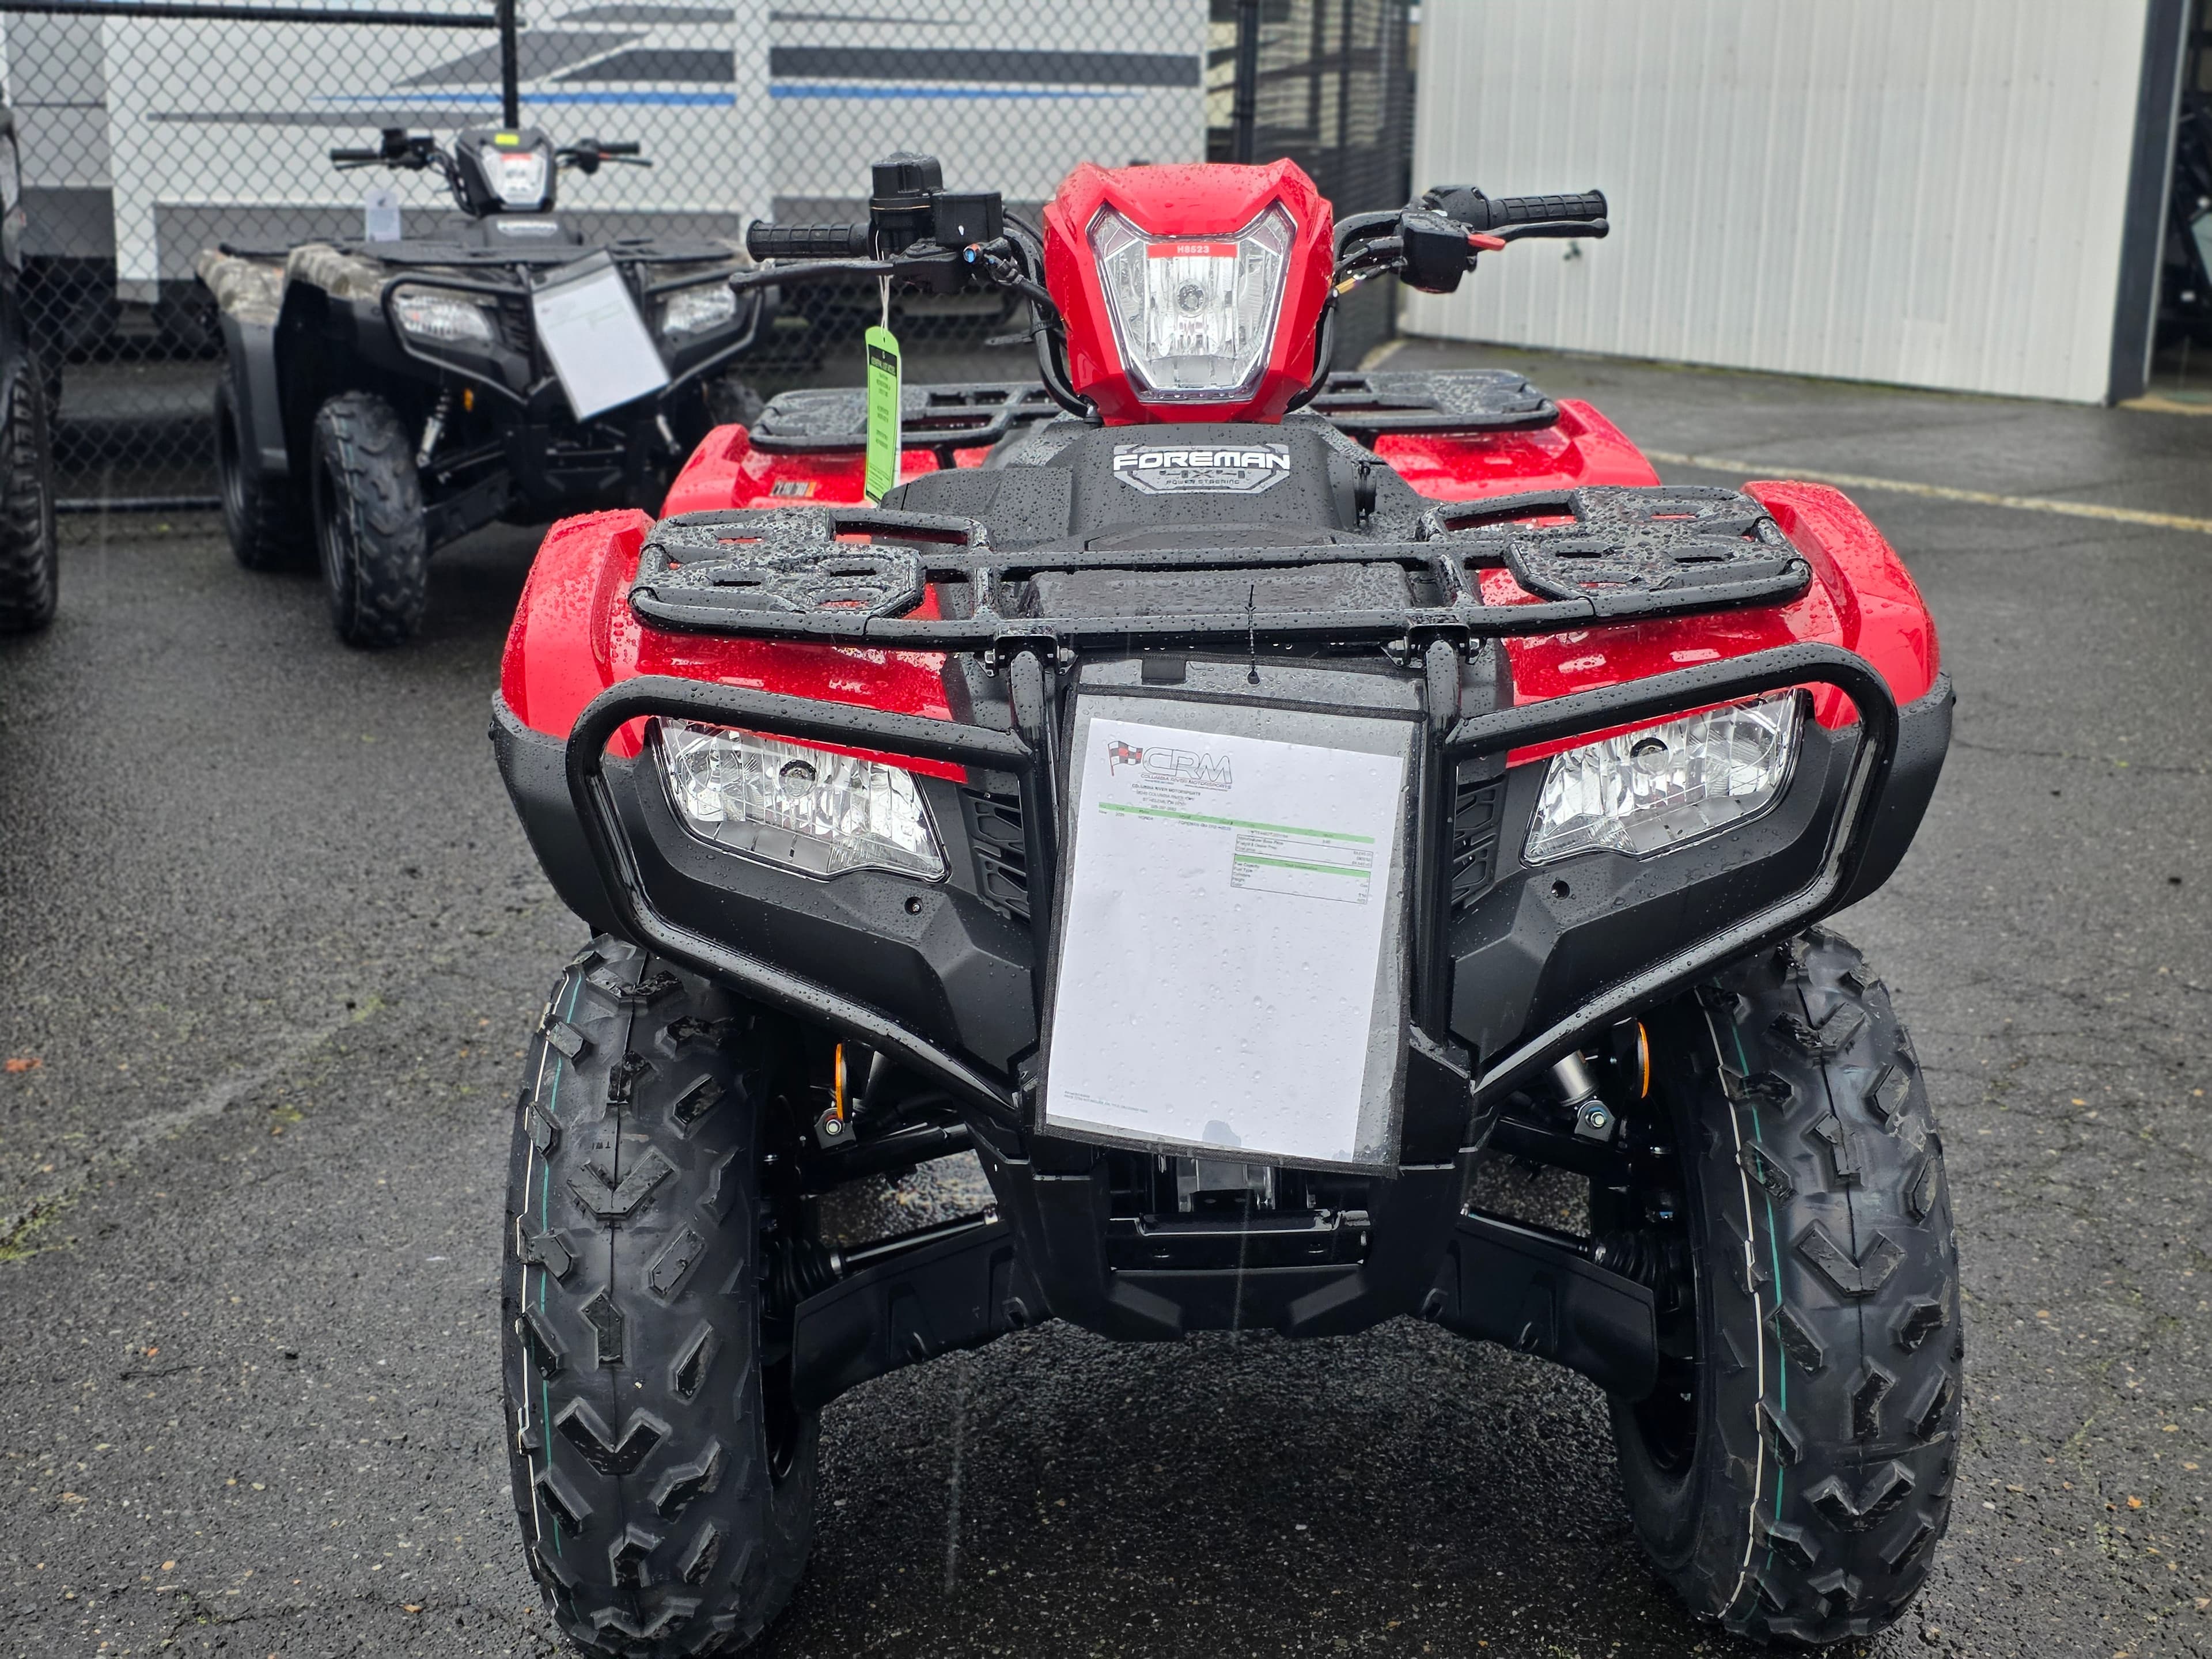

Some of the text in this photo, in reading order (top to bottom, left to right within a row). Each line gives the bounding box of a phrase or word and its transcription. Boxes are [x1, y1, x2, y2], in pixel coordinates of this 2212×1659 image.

[1113, 451, 1290, 471] FOREMAN
[1142, 747, 1233, 784] CRM
[1188, 779, 1232, 789] MOTORSPORTS
